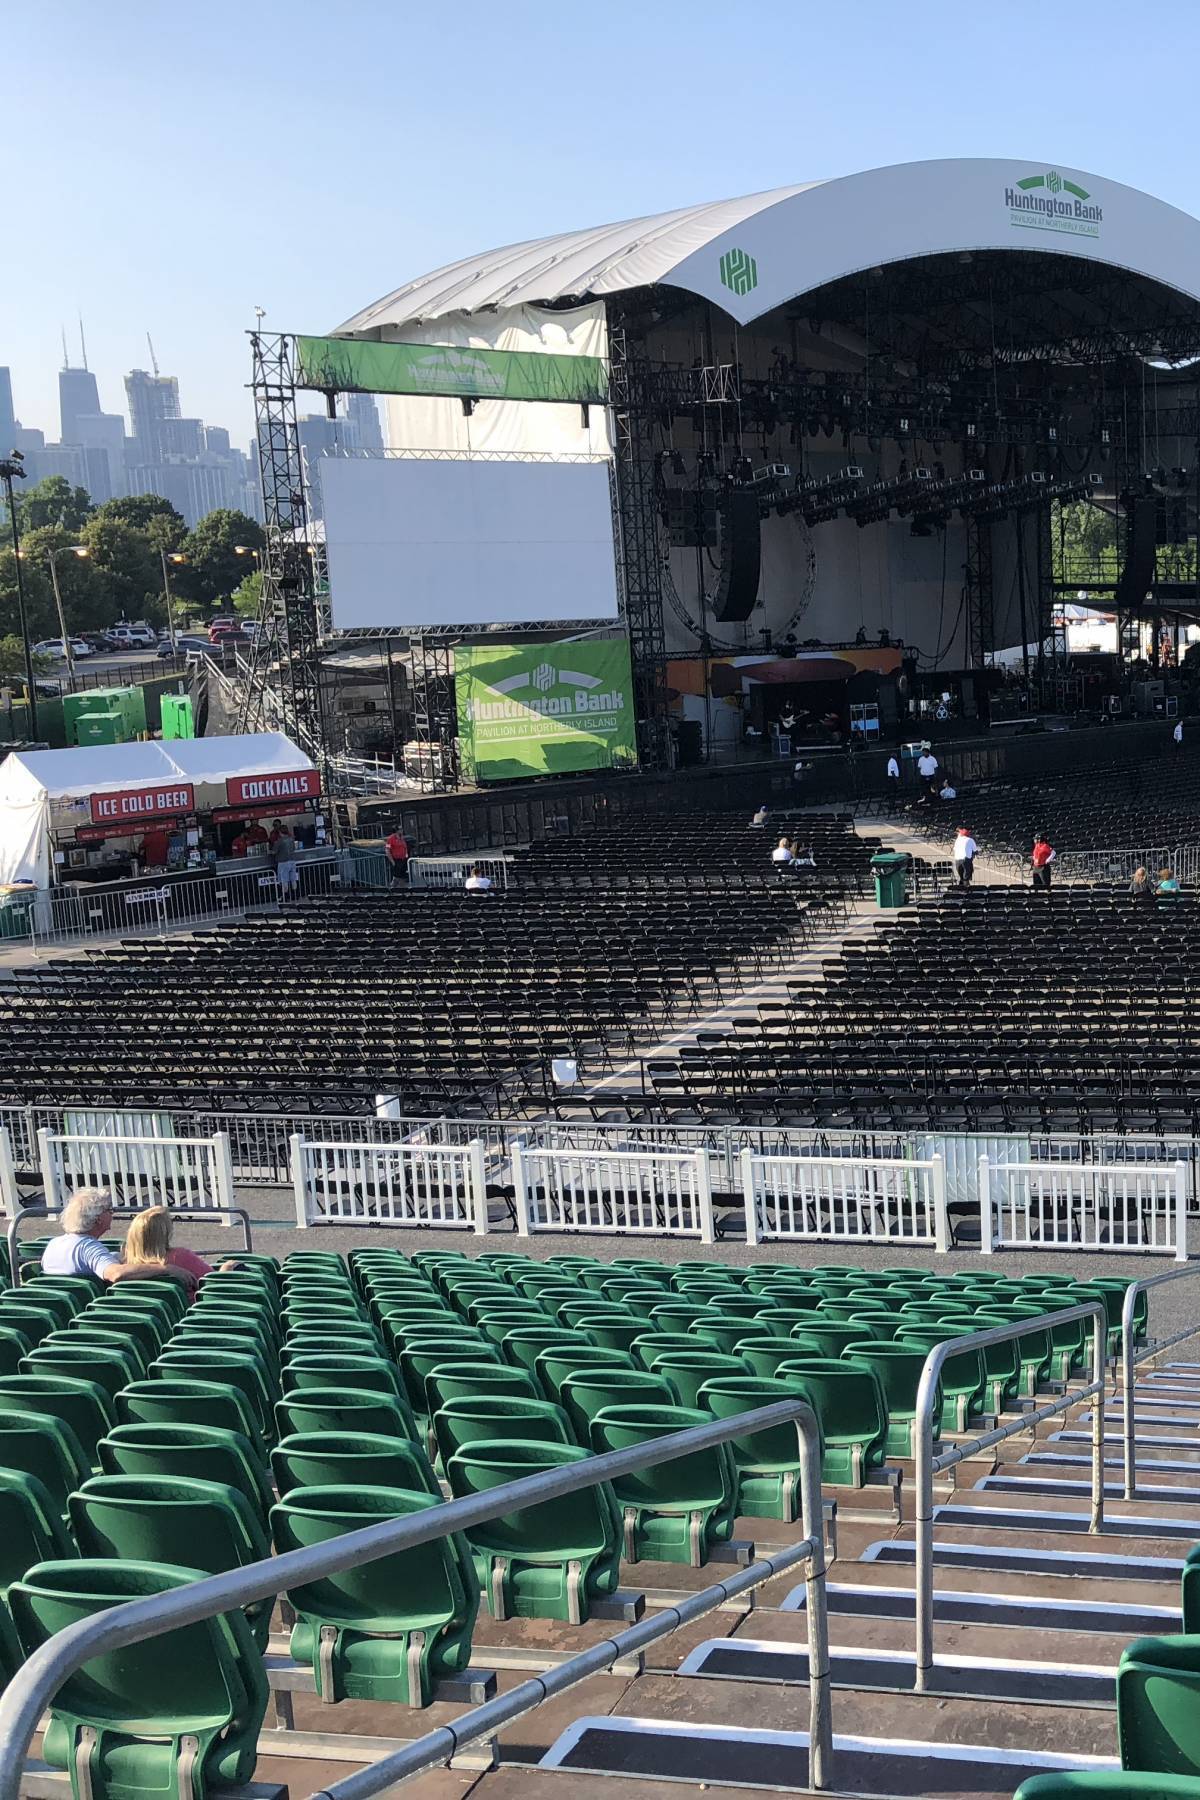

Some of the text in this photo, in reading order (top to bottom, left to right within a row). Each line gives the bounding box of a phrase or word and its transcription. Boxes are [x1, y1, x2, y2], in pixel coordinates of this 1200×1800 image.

[1004, 188, 1103, 221] Huntington Bank
[467, 689, 624, 721] Huntington Bank
[476, 716, 617, 738] PAVILION AT NORTHERLY ISLAND
[241, 776, 309, 800] COCKTAILS
[98, 790, 188, 816] ICE COLD BEER
[127, 893, 143, 902] LIVE
